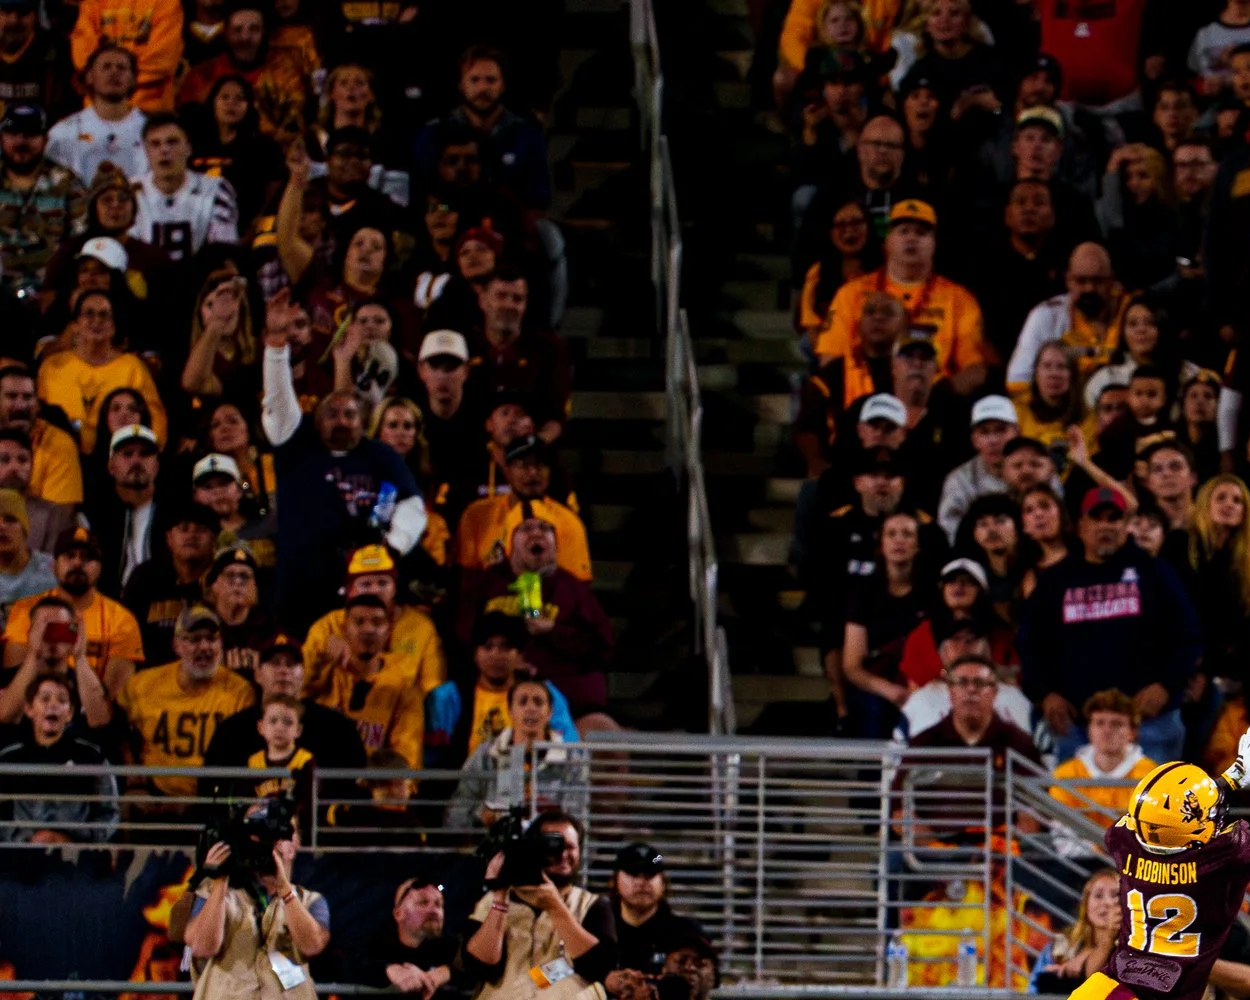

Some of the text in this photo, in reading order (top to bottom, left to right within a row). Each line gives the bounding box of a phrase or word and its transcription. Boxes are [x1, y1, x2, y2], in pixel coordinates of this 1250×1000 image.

[1122, 853, 1197, 885] J. ROBINSON
[1127, 888, 1202, 958] 12
